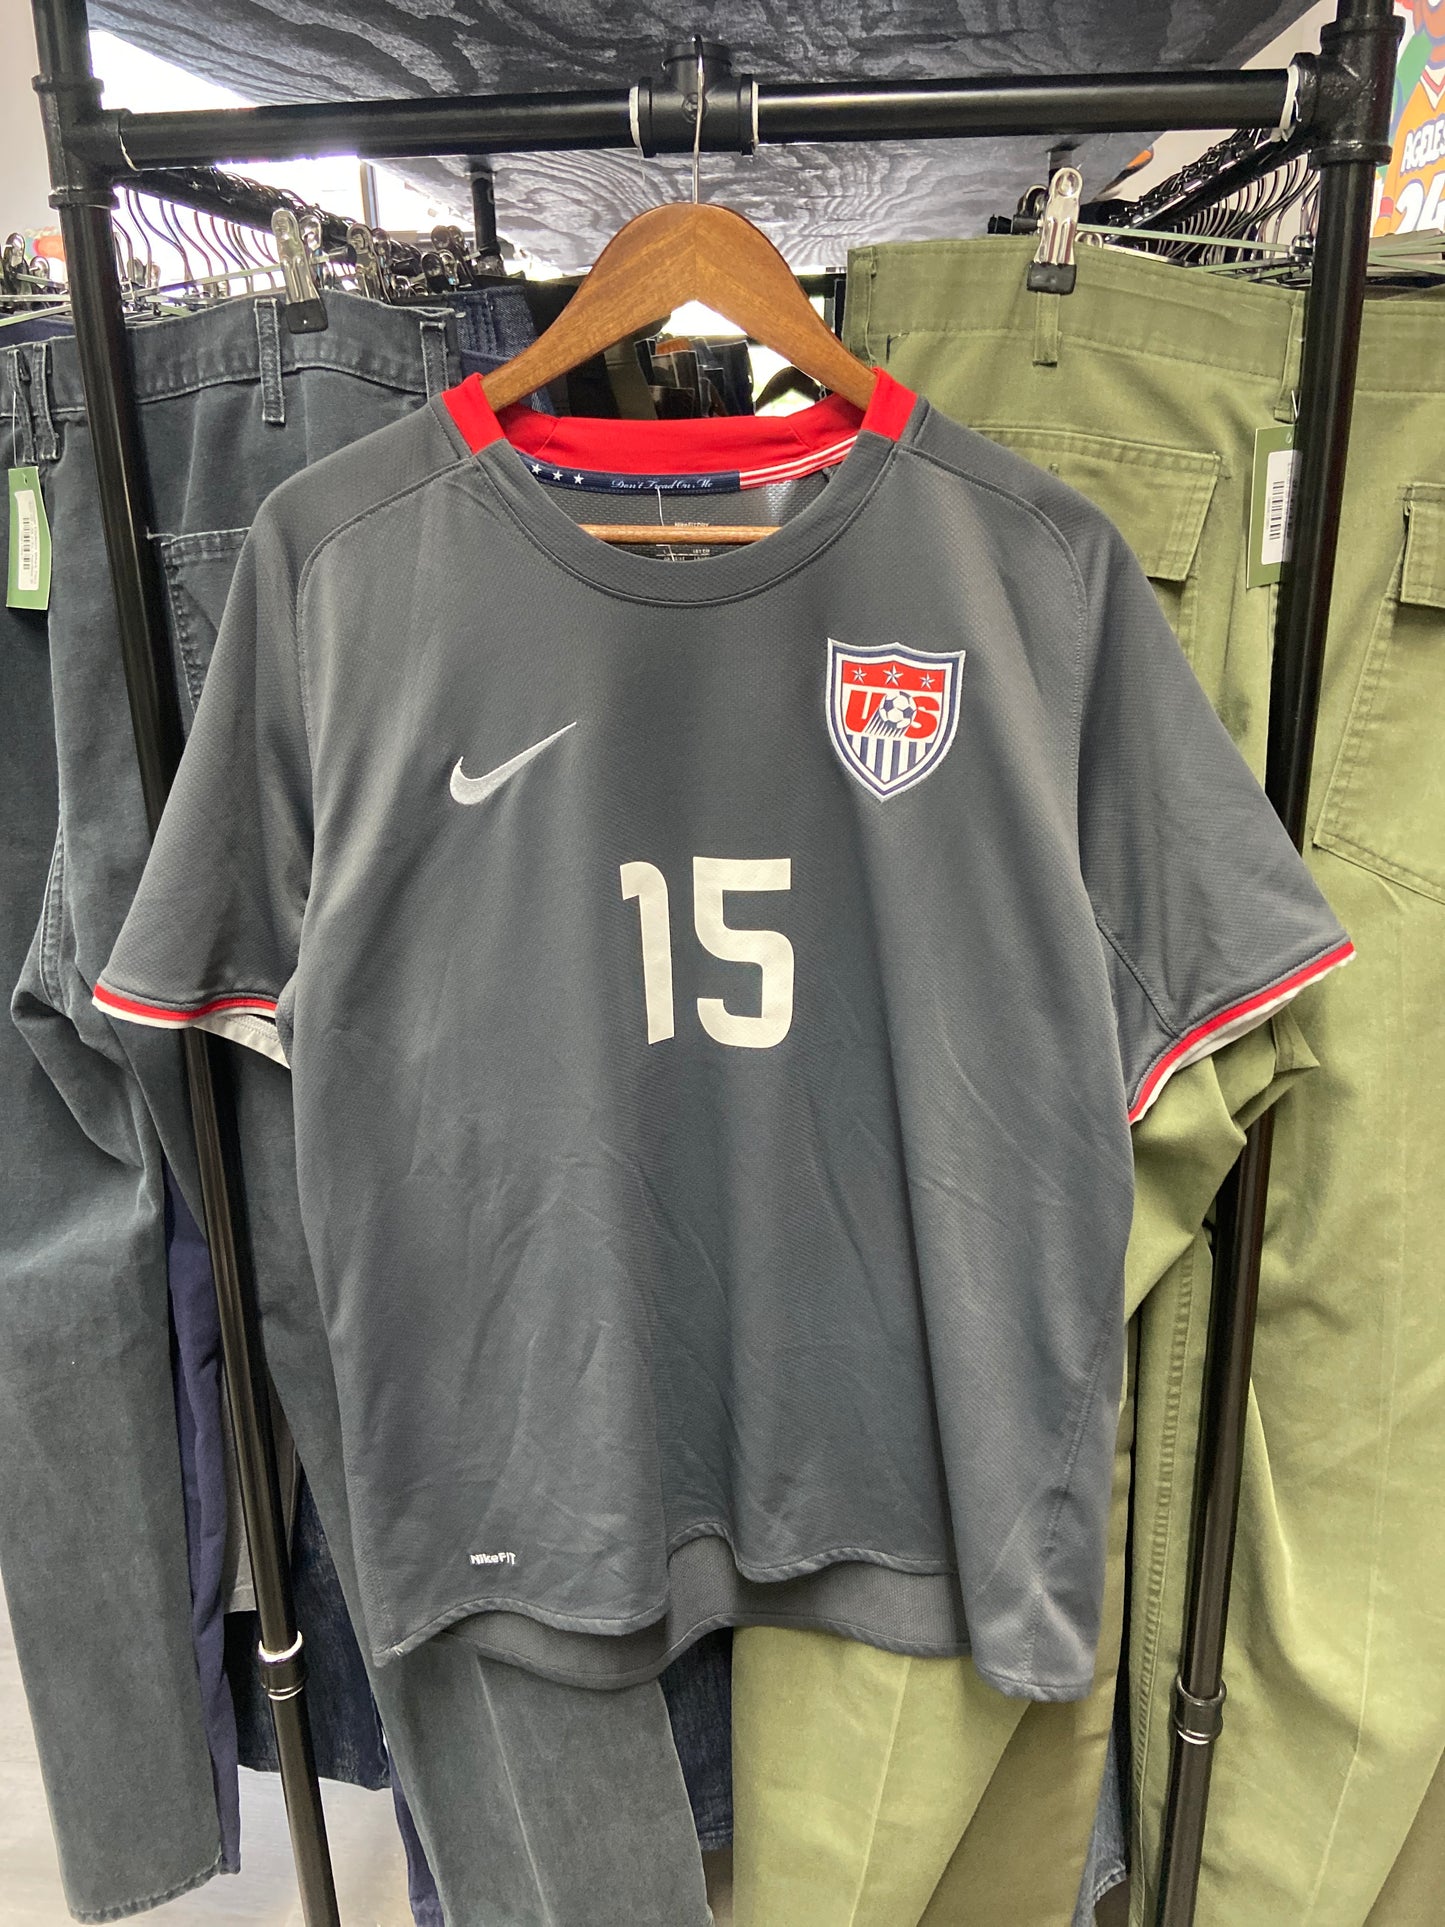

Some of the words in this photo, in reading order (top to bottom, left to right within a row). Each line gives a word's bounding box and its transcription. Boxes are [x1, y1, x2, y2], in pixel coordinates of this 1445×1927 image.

[611, 480, 644, 489] Don't
[643, 480, 677, 490] Tread
[692, 478, 713, 488] Me
[845, 689, 940, 739] US
[619, 856, 795, 1049] 15
